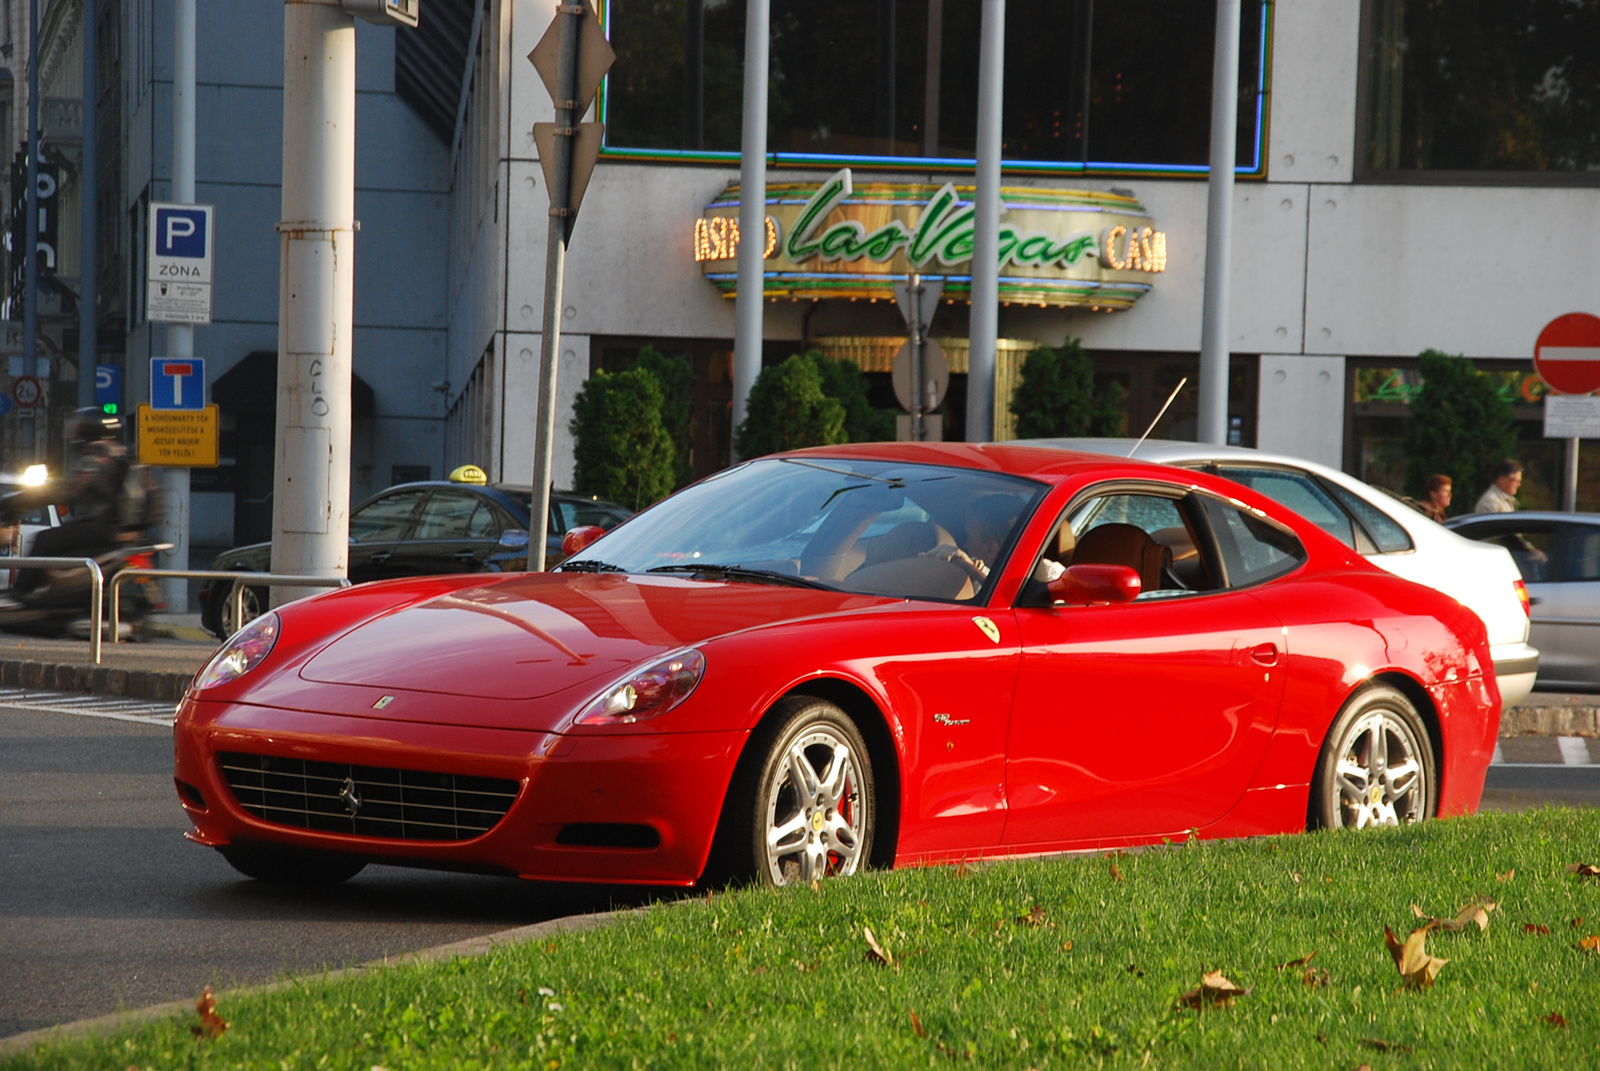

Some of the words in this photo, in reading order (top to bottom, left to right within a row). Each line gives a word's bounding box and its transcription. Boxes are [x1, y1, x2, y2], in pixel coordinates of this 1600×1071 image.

[784, 168, 912, 264] Las
[908, 182, 1101, 270] Vegas
[166, 216, 196, 250] P
[159, 262, 201, 277] ZÓNA
[463, 468, 482, 478] TAXI
